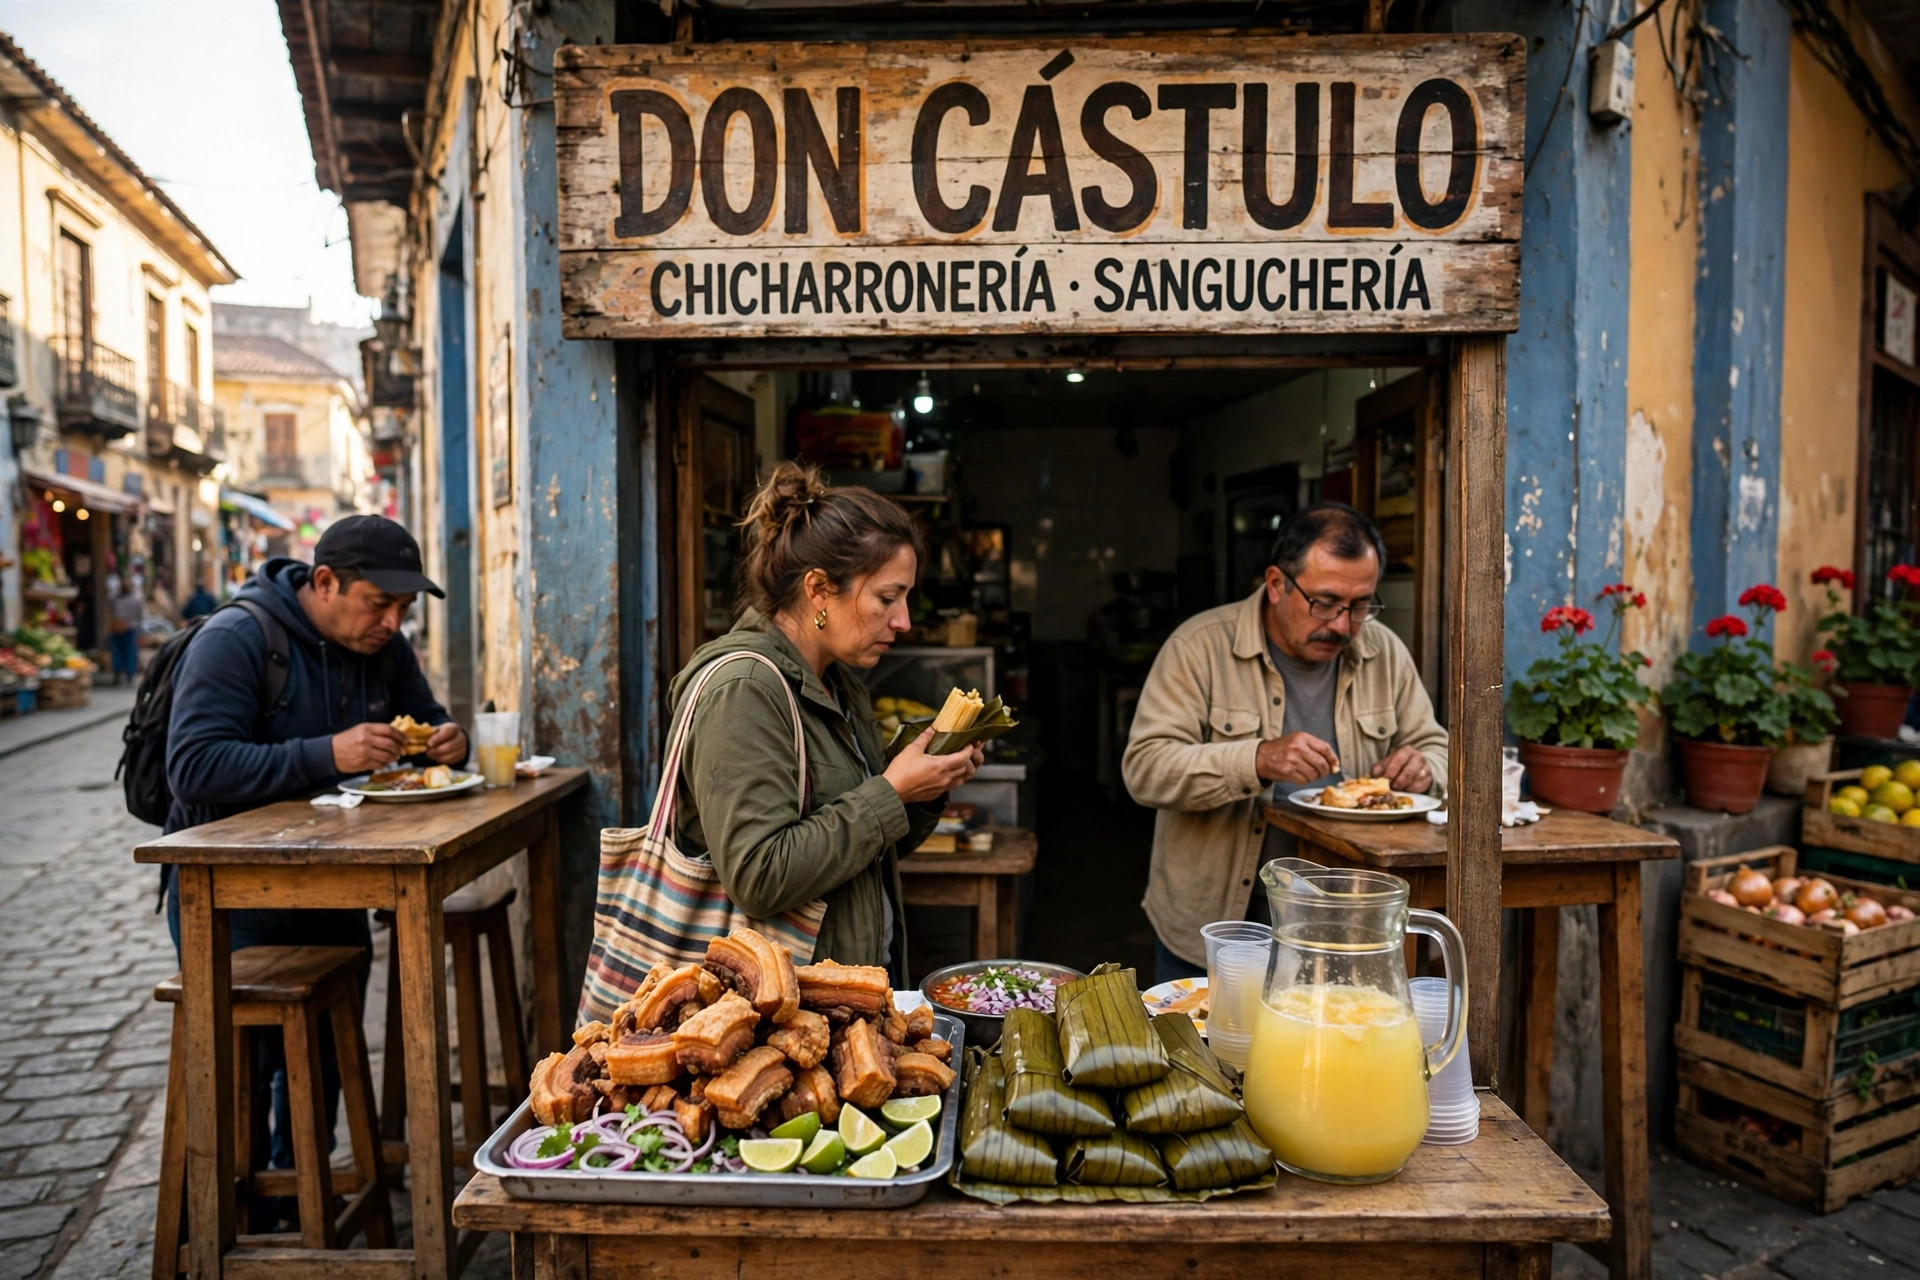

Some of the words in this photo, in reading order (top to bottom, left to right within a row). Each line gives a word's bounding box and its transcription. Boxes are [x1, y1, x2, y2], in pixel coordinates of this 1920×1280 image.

[609, 86, 862, 239] DON
[910, 48, 1479, 234] CÁSTULO
[650, 244, 1056, 318] CHICHARRONERÍA
[1094, 243, 1432, 313] SANGUCHERÍA
